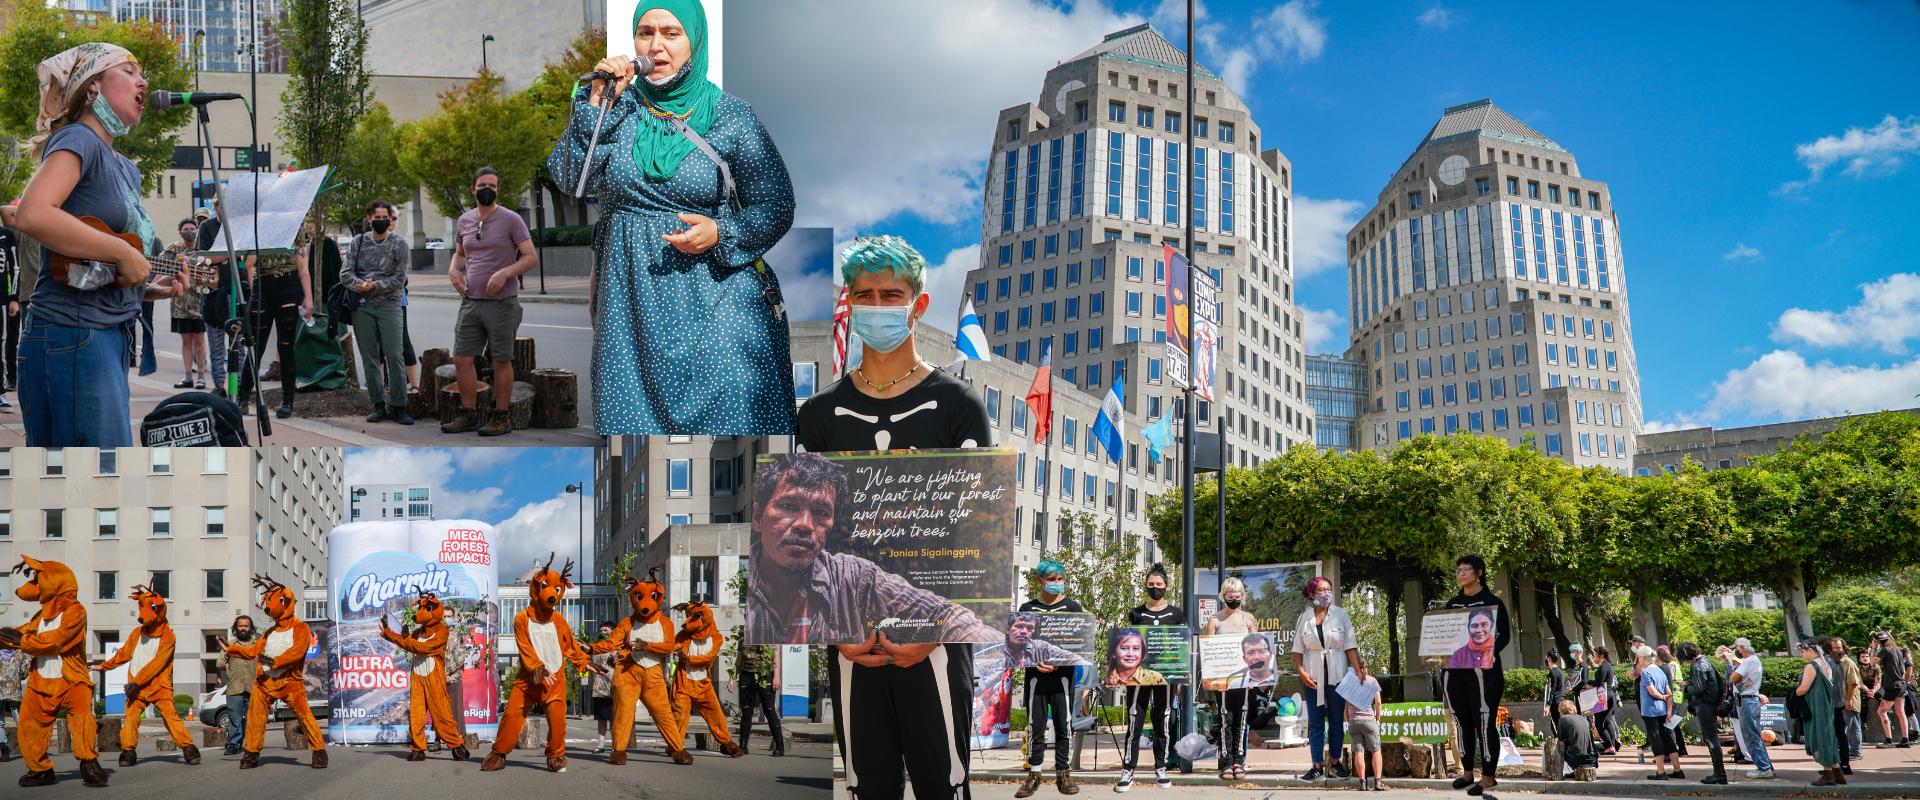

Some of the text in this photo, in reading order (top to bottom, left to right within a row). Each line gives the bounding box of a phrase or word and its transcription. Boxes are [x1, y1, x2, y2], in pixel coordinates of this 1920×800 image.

[1195, 278, 1216, 304] COMIC
[1195, 294, 1216, 323] EXPO
[150, 422, 204, 443] STOP LINE 3
[899, 475, 924, 484] are
[925, 469, 981, 492] fighting
[853, 486, 1005, 508] to plant in our forest
[852, 502, 973, 526] and maintain our
[449, 530, 484, 541] MEGA
[852, 524, 907, 546] benzoin
[443, 541, 488, 552] FOREST
[889, 548, 918, 558] Jonias
[920, 547, 980, 560] Sigalingging
[440, 552, 490, 564] IMPACTS
[348, 562, 449, 612] Charmin
[343, 656, 394, 670] ULTRA
[334, 672, 408, 688] WRONG
[1395, 708, 1404, 716] to
[1408, 707, 1423, 716] the
